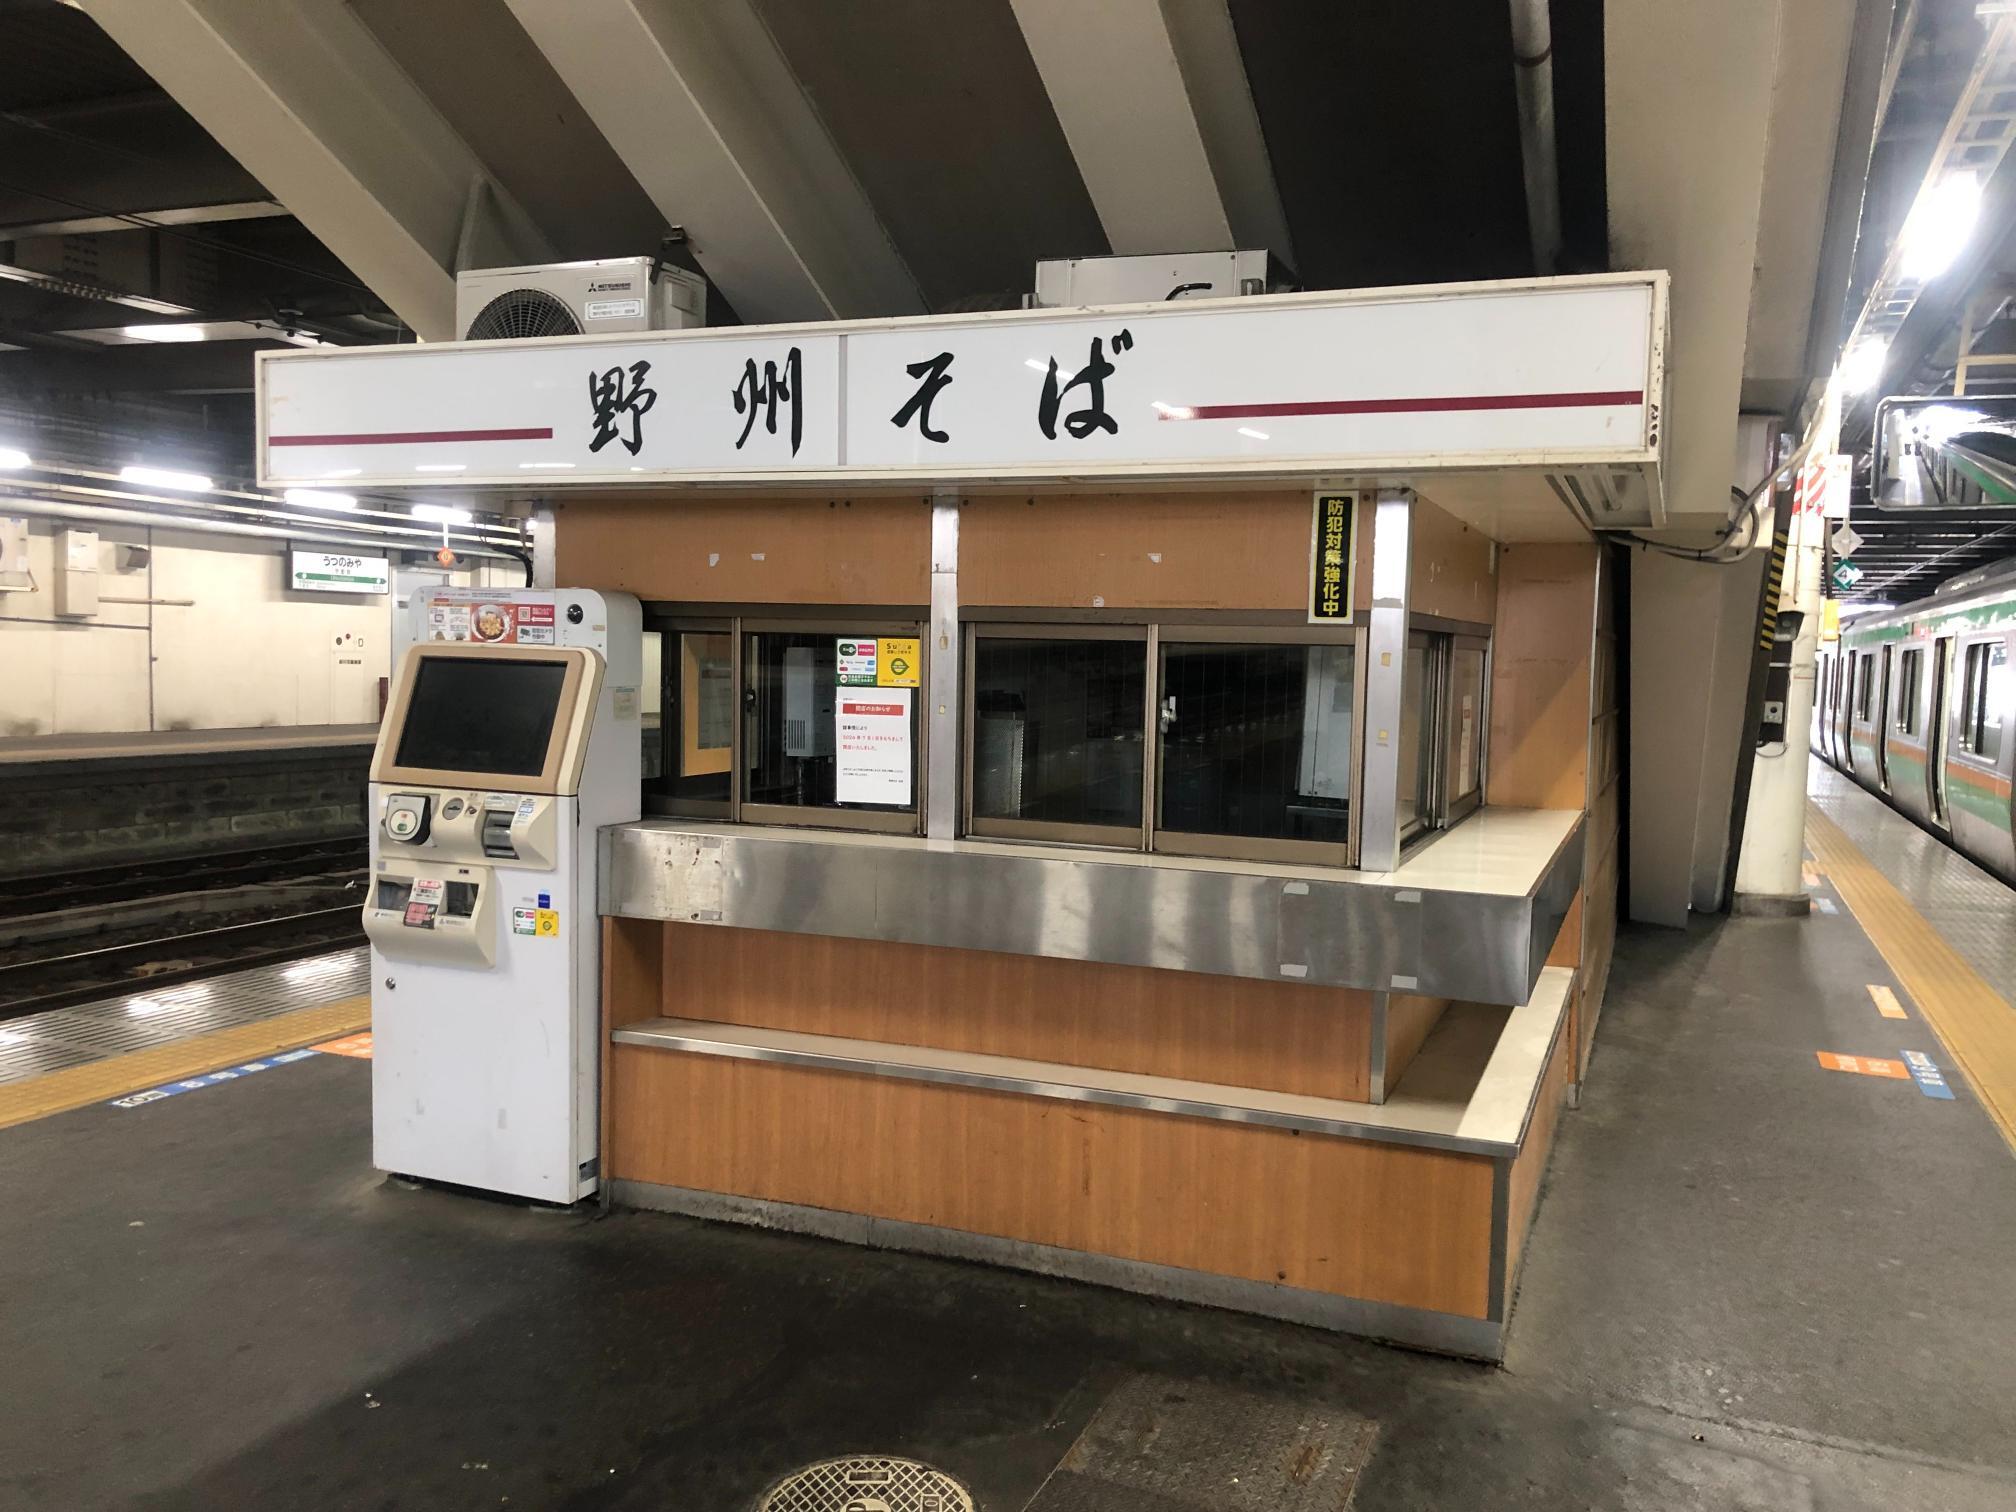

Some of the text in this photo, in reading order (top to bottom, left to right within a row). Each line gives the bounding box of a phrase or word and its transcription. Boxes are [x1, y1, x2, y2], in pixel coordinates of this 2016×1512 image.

[588, 328, 1134, 458] 野州そば
[323, 556, 362, 568] うつのみや
[1322, 499, 1344, 616] 防犯対策強化中
[1838, 569, 1848, 579] 4
